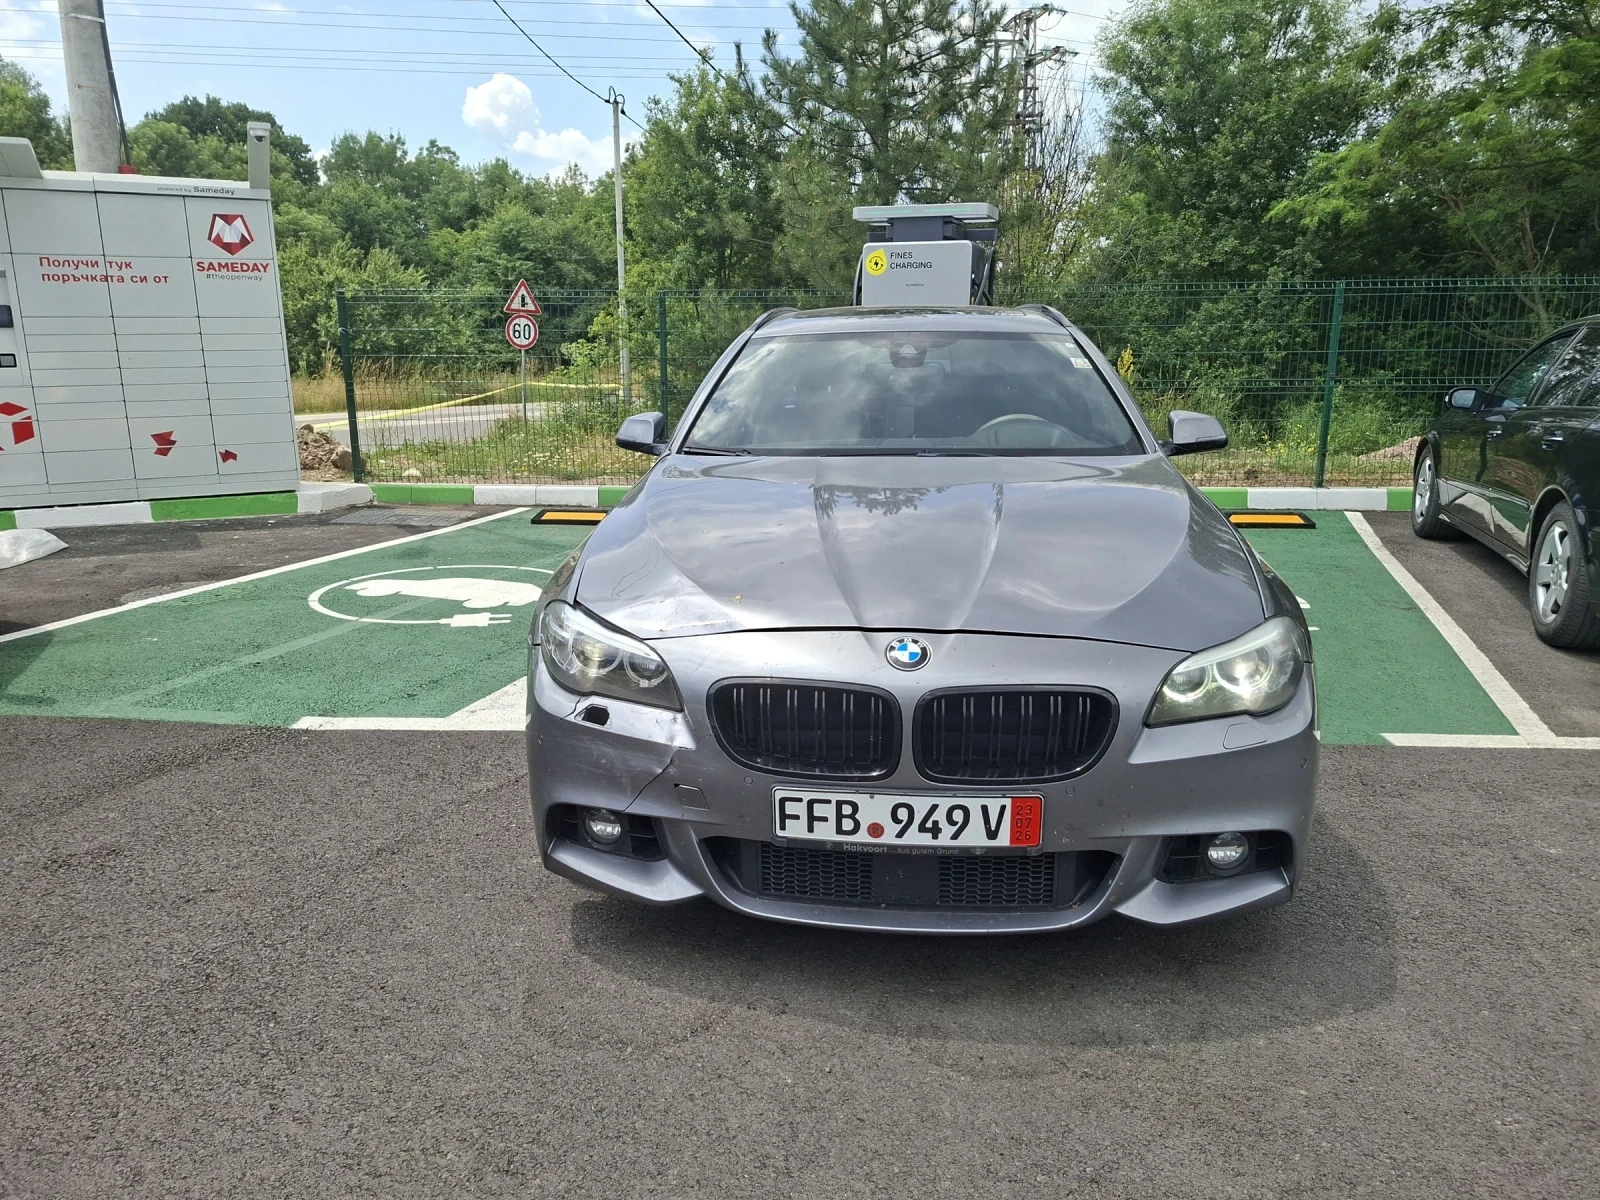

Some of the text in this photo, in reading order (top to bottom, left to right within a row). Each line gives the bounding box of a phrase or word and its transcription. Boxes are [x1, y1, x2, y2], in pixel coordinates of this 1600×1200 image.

[193, 186, 235, 195] Sameday
[890, 251, 913, 259] FINES
[39, 256, 133, 271] Получи тук
[196, 261, 269, 273] SAMEDAY
[890, 261, 932, 269] CHARGING
[41, 273, 169, 284] поръчката си от
[206, 273, 262, 282] #theopenway
[513, 322, 531, 340] 60
[1016, 804, 1033, 815] 23
[778, 796, 861, 836] FFB
[1015, 817, 1032, 828] 07
[1015, 830, 1032, 841] 26
[843, 843, 887, 853] Hakvoort
